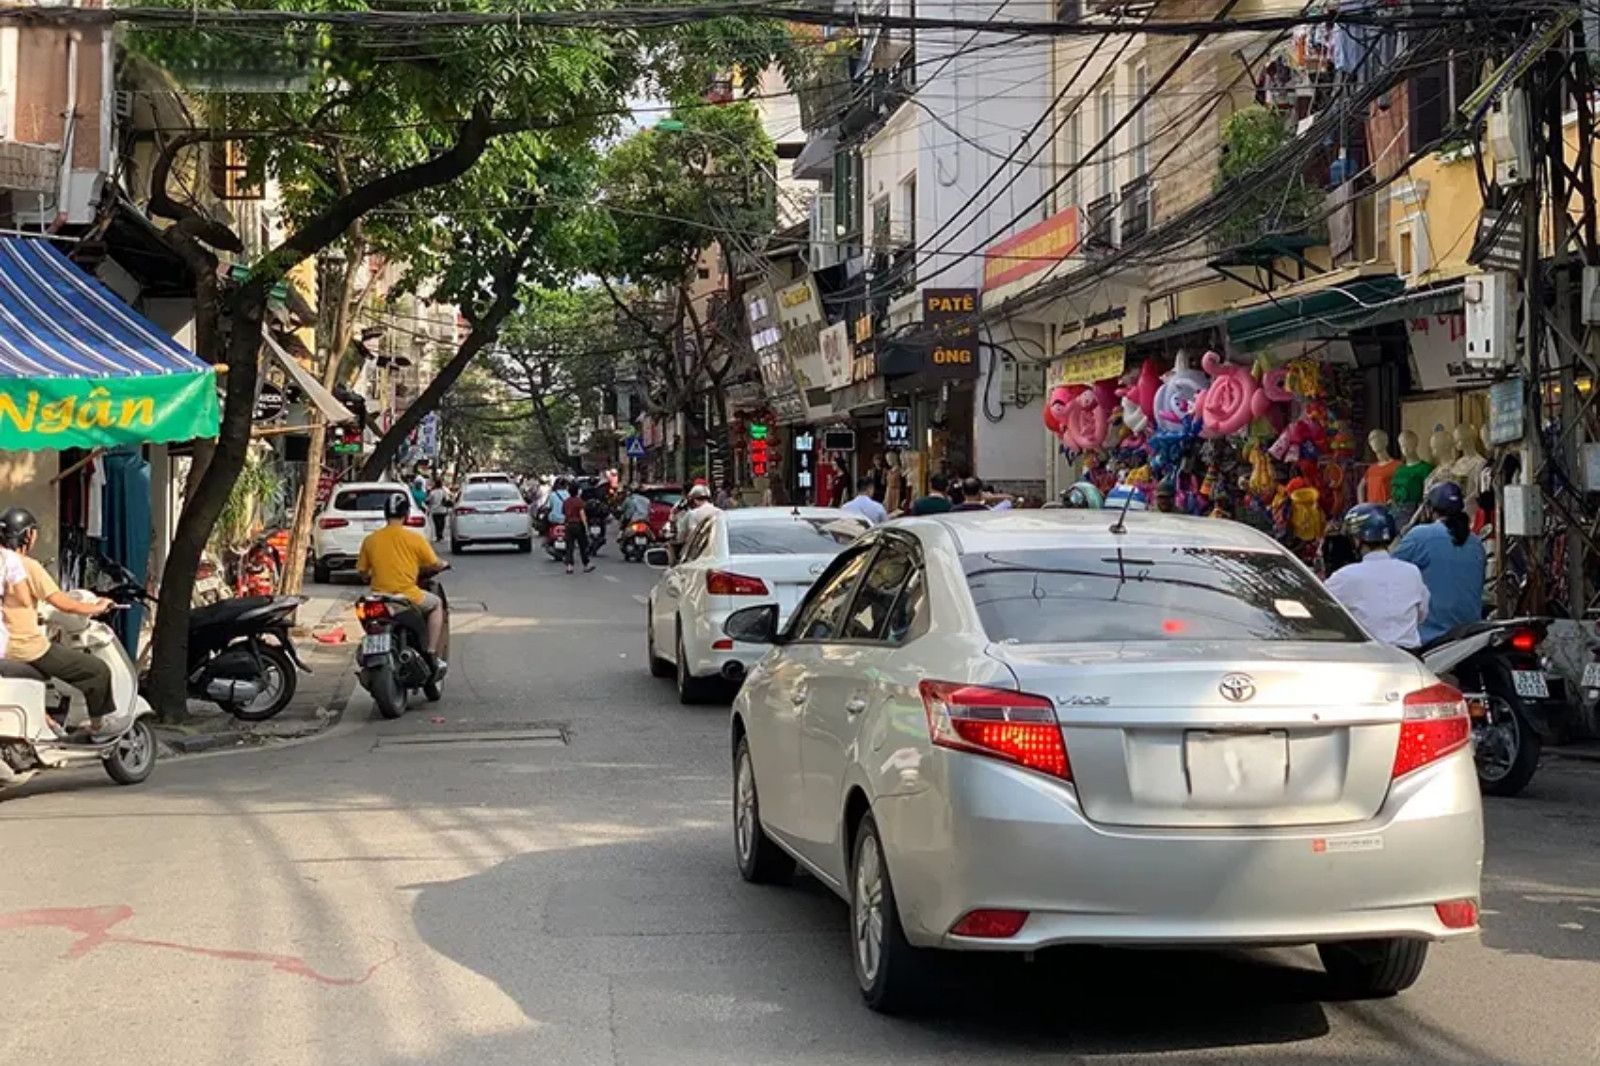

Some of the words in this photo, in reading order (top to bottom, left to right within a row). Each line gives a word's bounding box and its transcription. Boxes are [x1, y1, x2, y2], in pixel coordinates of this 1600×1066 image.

[928, 293, 974, 312] PATÊ
[933, 346, 972, 364] ÔNG
[0, 386, 155, 433] Ngân
